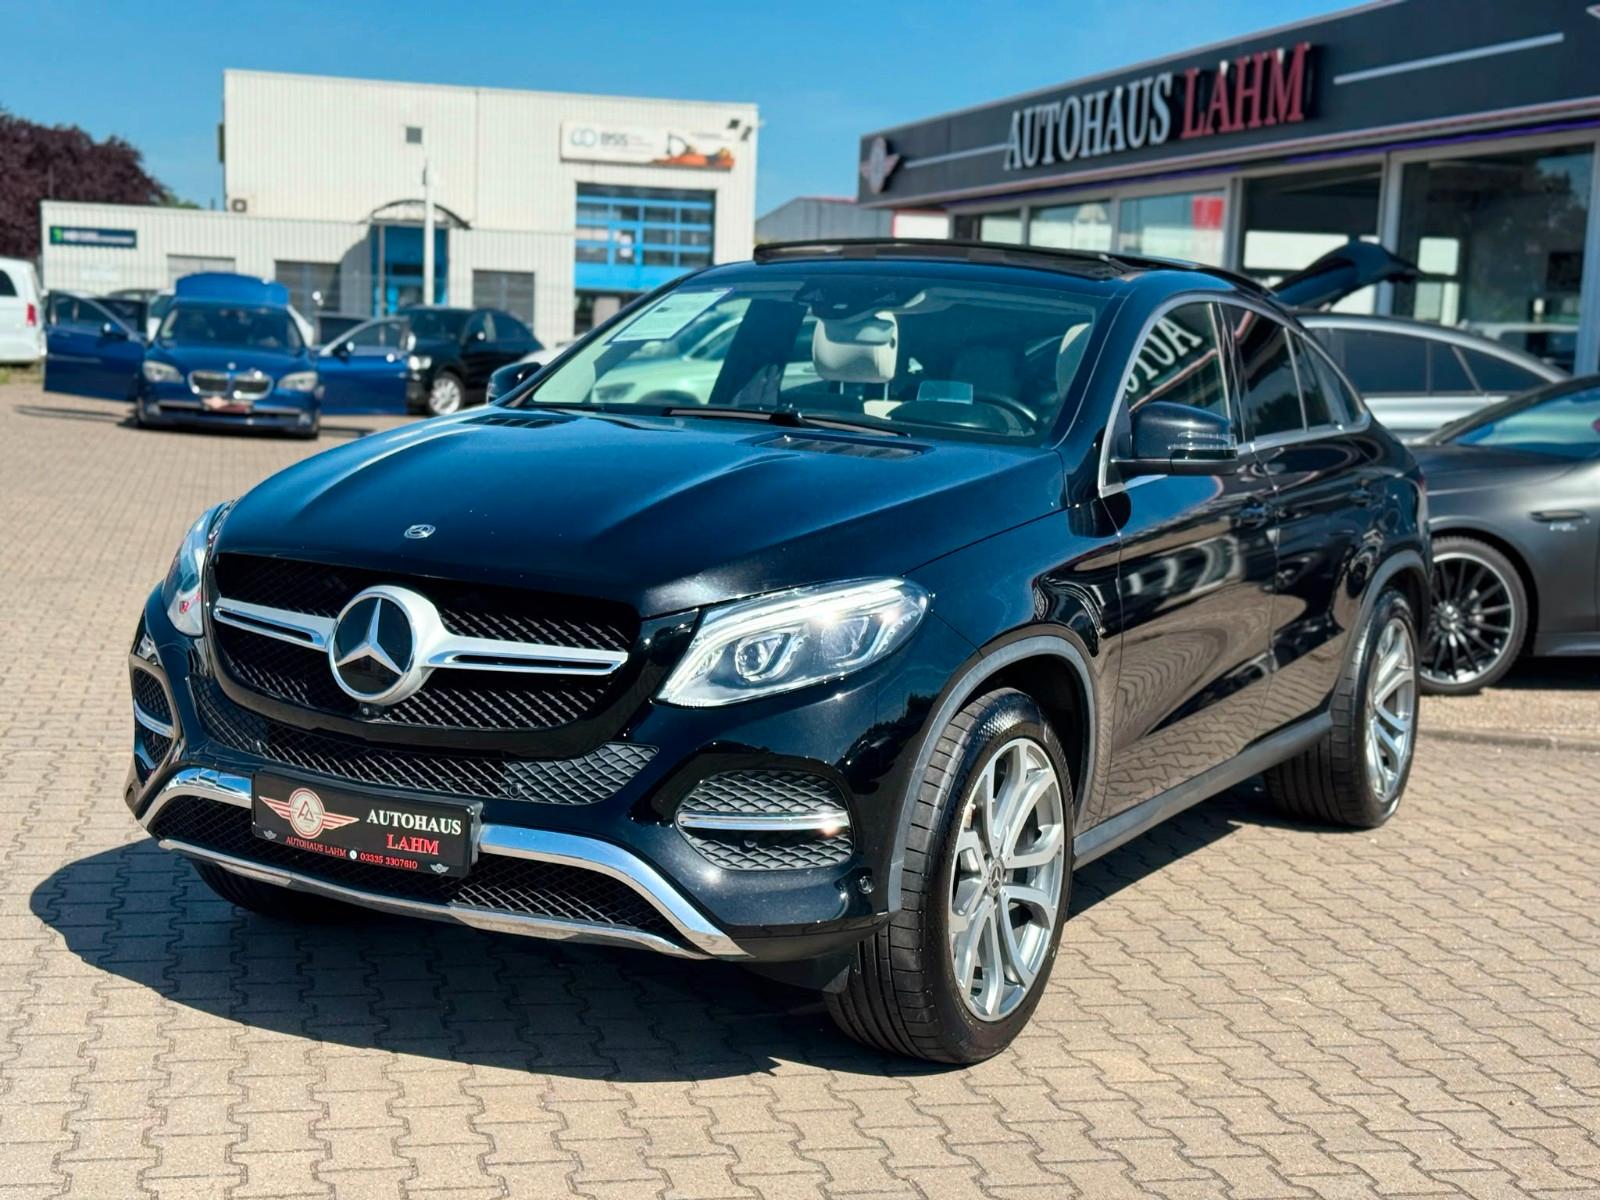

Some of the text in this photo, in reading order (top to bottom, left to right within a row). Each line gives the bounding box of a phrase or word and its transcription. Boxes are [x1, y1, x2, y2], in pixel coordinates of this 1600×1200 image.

[1003, 42, 1312, 171] AUTOHAUS LAHM
[366, 808, 462, 836] AUTOHAUS
[285, 836, 347, 858] AUTOHAUS LAHM
[386, 833, 440, 856] LAHM
[360, 852, 418, 870] 03335 3307610
